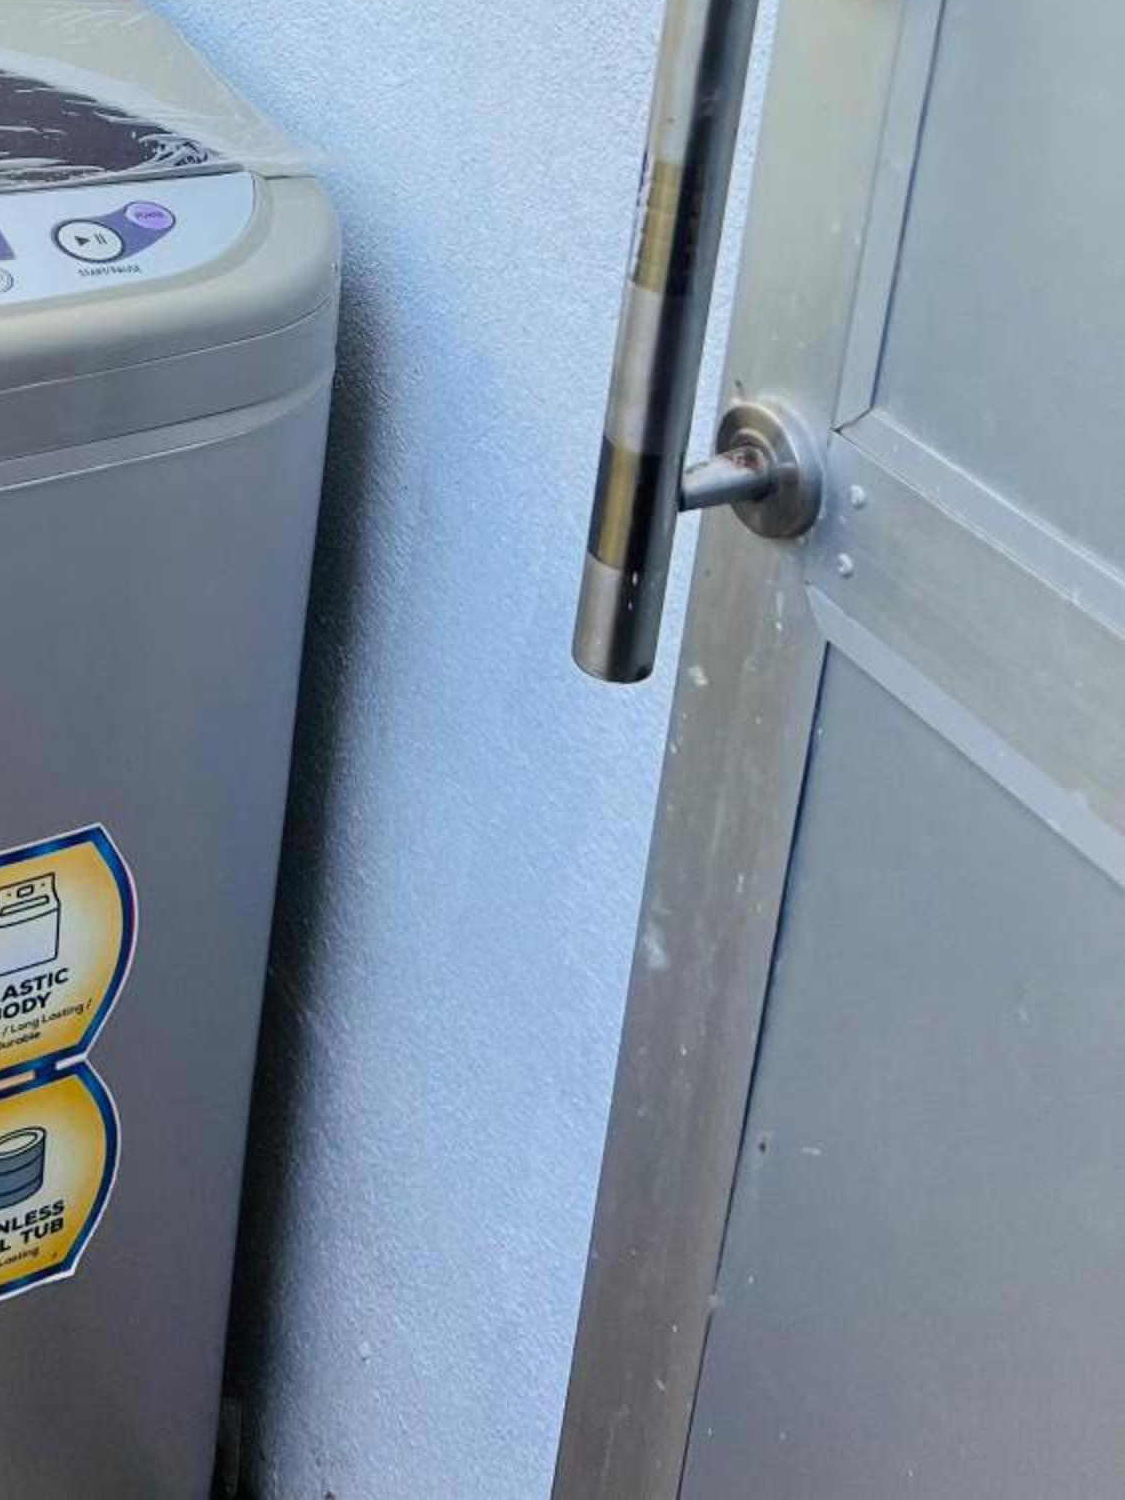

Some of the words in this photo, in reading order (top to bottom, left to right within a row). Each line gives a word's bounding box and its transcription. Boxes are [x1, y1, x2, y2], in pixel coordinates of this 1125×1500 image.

[10, 1018, 40, 1034] Long
[42, 1004, 84, 1023] Lasting
[20, 1217, 64, 1244] TUB
